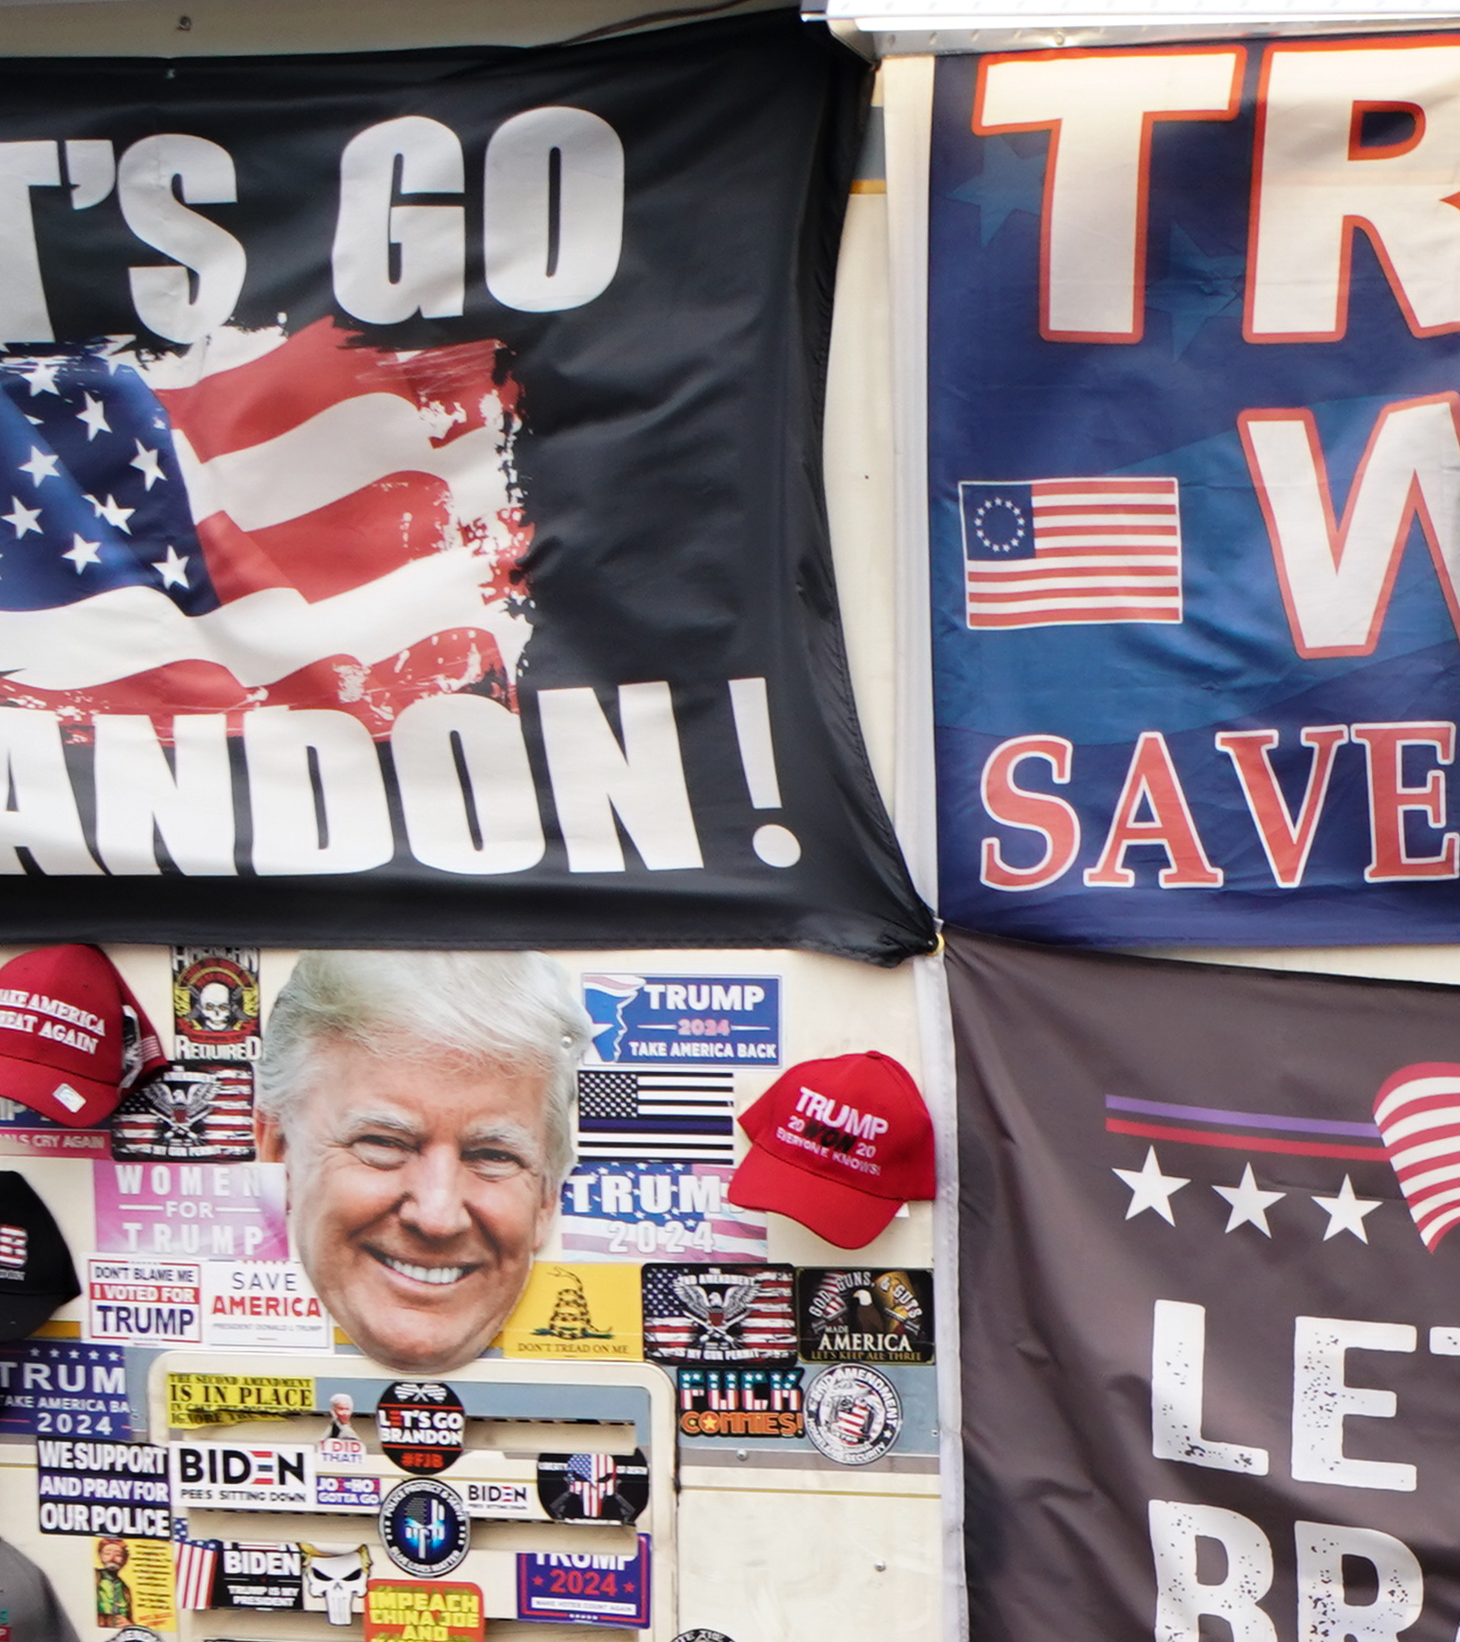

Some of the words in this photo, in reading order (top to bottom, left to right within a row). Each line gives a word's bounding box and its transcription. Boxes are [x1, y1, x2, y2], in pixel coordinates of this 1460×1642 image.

[331, 105, 625, 324] GO
[644, 984, 765, 1011] TRUMP
[38, 1021, 99, 1055] AGAIN
[677, 1019, 731, 1036] 2024
[629, 1042, 666, 1056] TAKE
[670, 1043, 734, 1058] AMERICA
[737, 1044, 777, 1059] BACK
[796, 1086, 888, 1141] TRUMP
[115, 1165, 261, 1197] WOMEN
[166, 1201, 214, 1218] FOR
[122, 1222, 264, 1256] TRUMP
[609, 1220, 716, 1254] 2024
[95, 1266, 130, 1280] DON'T
[134, 1267, 173, 1282] BLAME
[178, 1270, 194, 1282] ME
[231, 1272, 298, 1291] SAVE
[94, 1285, 101, 1298] I
[103, 1284, 159, 1301] VOTED
[161, 1288, 196, 1303] FOR
[212, 1296, 322, 1318] AMERICA
[96, 1305, 194, 1335] TRUMP
[819, 1333, 913, 1353] AMERICA
[171, 1385, 192, 1401] IS
[204, 1386, 228, 1403] IN
[240, 1387, 312, 1406] PLACE
[679, 1370, 804, 1411] FUCK
[37, 1397, 104, 1412] AMERICA
[37, 1413, 113, 1435] 2024
[378, 1409, 431, 1429] LET'S
[433, 1412, 463, 1429] GO
[680, 1410, 804, 1436] COMMIES!
[379, 1429, 462, 1446] BRANDON
[38, 1440, 74, 1468] WE
[74, 1443, 167, 1474] SUPPORT
[179, 1448, 305, 1485] BIDEN
[321, 1453, 362, 1464] THAT!
[40, 1476, 81, 1496] AND
[83, 1479, 133, 1499] PRAY
[134, 1482, 169, 1502] FOR
[41, 1503, 88, 1531] OUR
[91, 1506, 170, 1537] POLICE
[223, 1550, 301, 1576] BIDEN
[549, 1569, 618, 1596] 2024
[370, 1590, 480, 1612] IMPEACH
[370, 1610, 434, 1626] CHINA
[439, 1611, 480, 1628] JOE
[402, 1625, 448, 1642] AND
